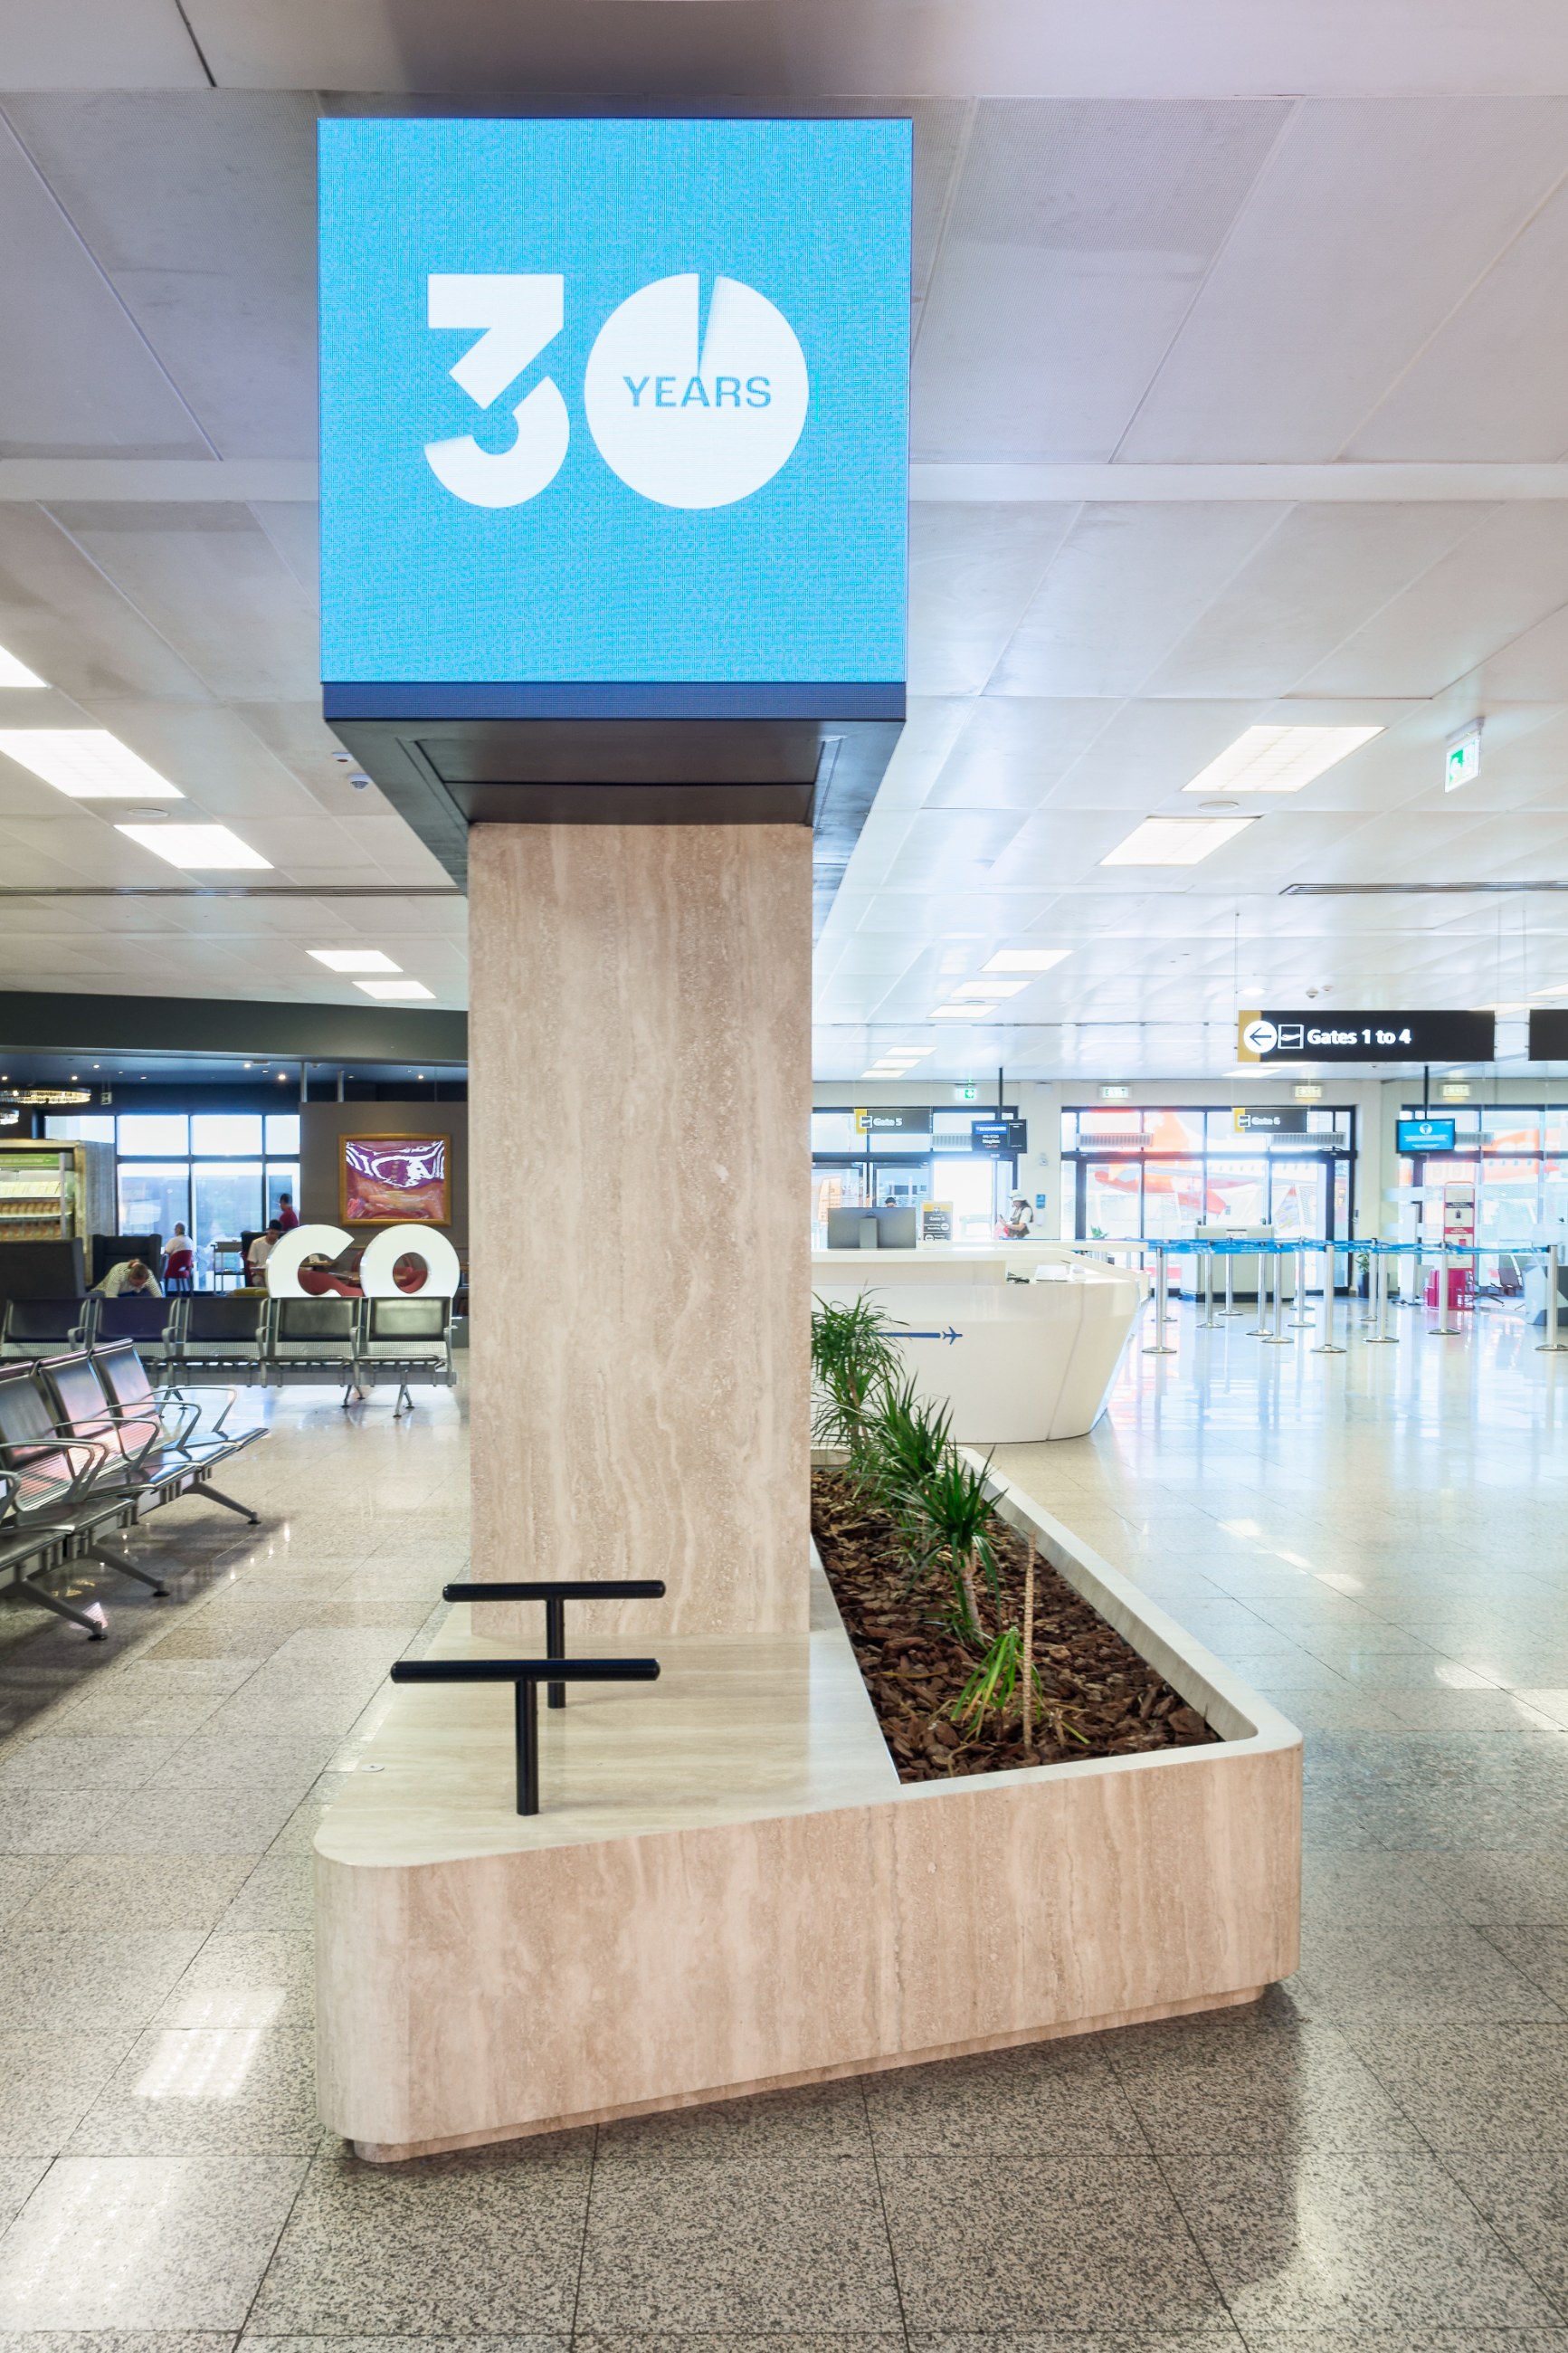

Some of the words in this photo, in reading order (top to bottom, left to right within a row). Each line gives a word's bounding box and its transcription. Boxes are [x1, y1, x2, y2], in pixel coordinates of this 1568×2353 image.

[424, 272, 809, 509] 30
[622, 376, 772, 408] YEARS
[1307, 1029, 1357, 1044] Gates
[1362, 1029, 1371, 1043] 1
[1375, 1029, 1396, 1044] to
[1399, 1029, 1411, 1043] 4
[873, 1118, 895, 1127] Gate
[896, 1118, 903, 1126] 5
[1251, 1117, 1273, 1125] Gate
